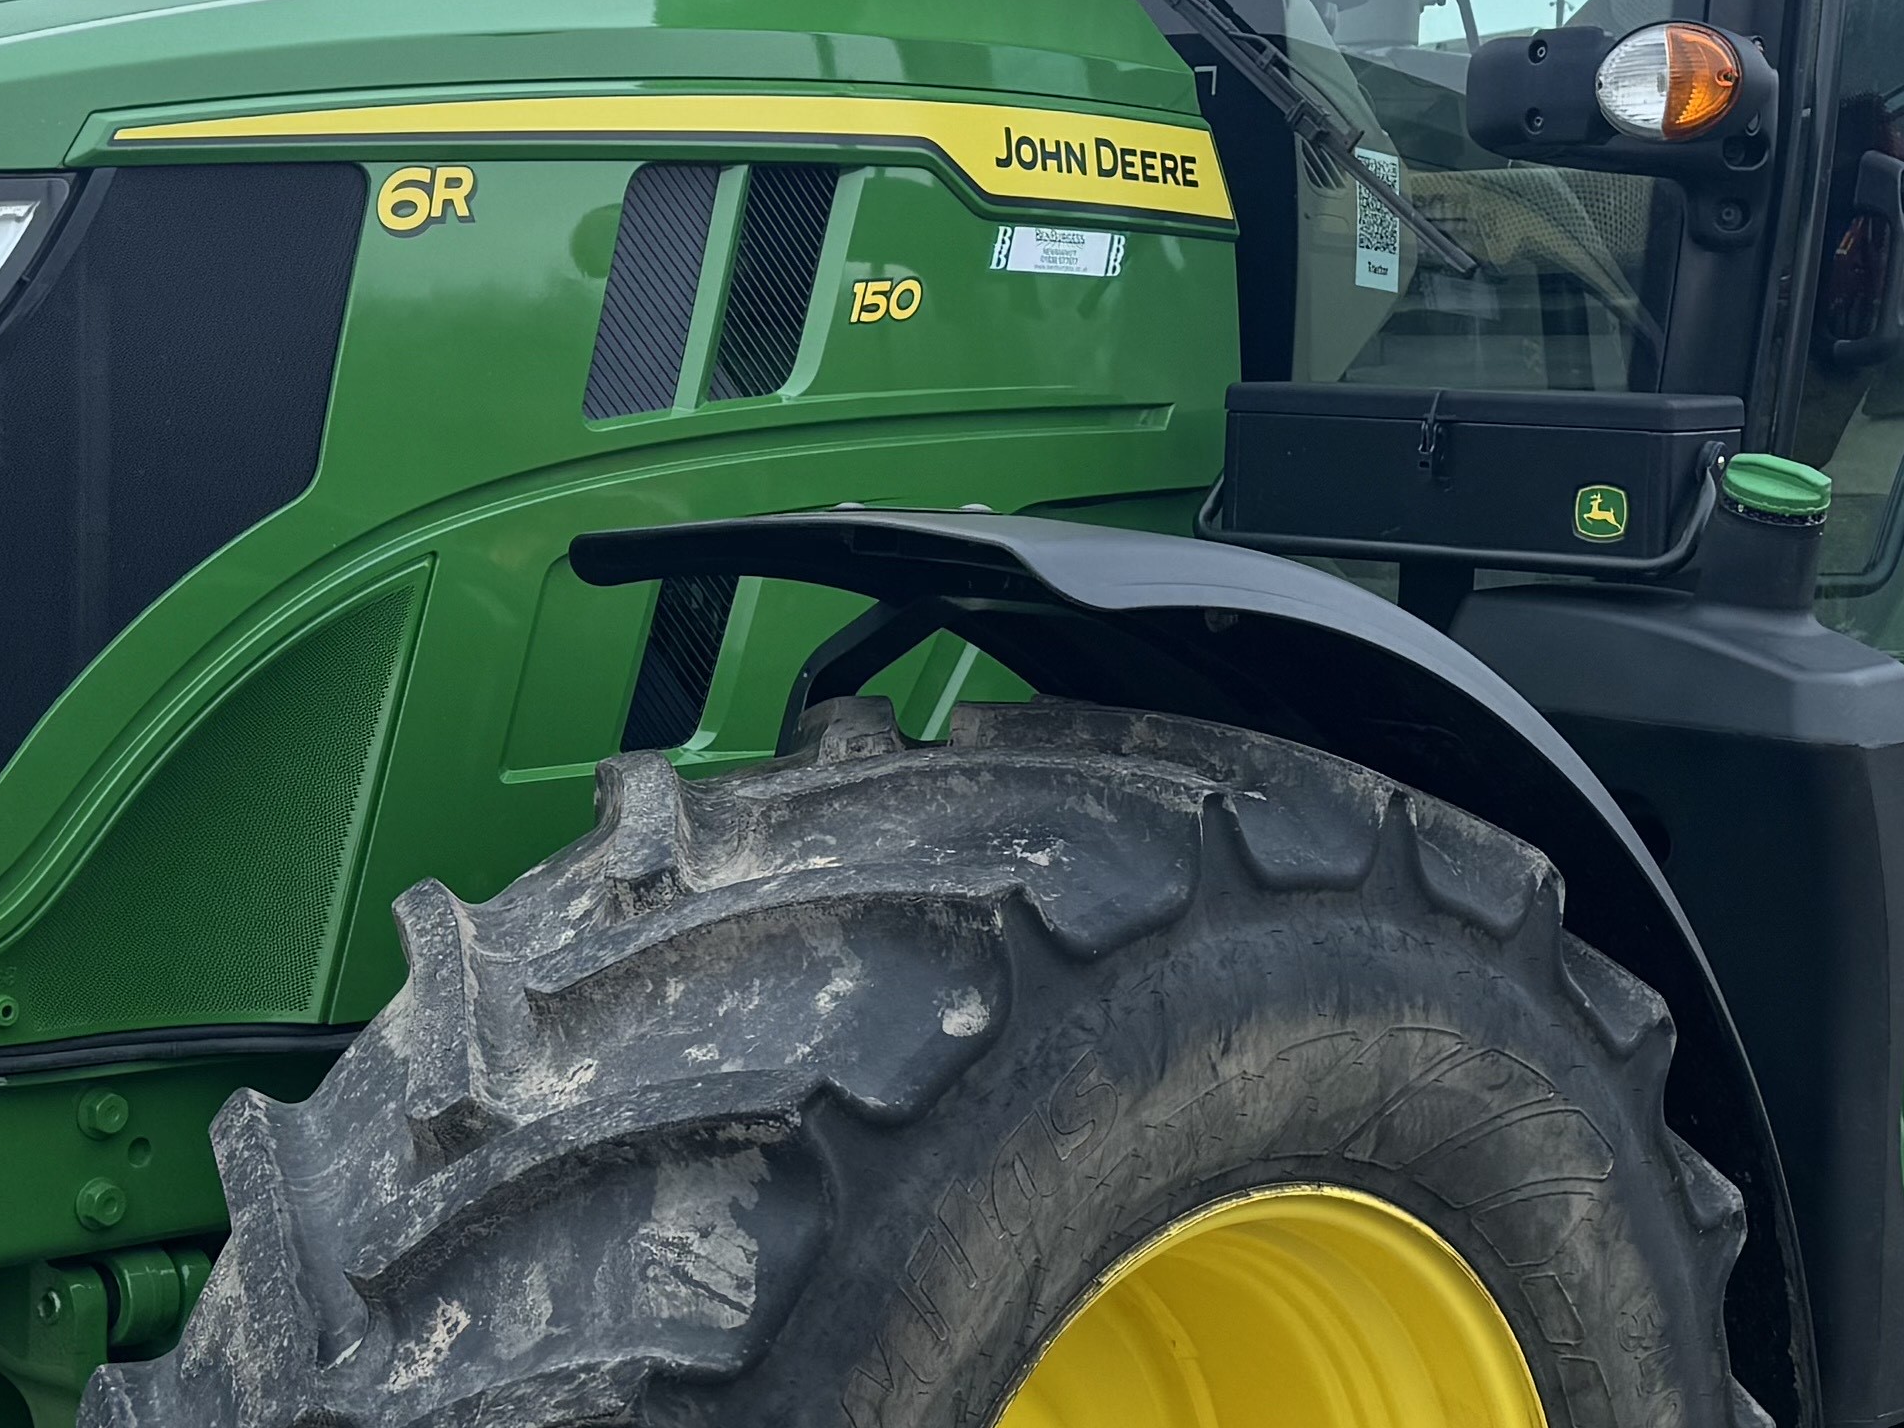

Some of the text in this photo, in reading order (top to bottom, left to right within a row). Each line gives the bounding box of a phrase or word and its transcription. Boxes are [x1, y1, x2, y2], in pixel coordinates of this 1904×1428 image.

[996, 127, 1199, 187] JOHN DEERE
[376, 165, 478, 234] 6R
[849, 278, 923, 324] 150
